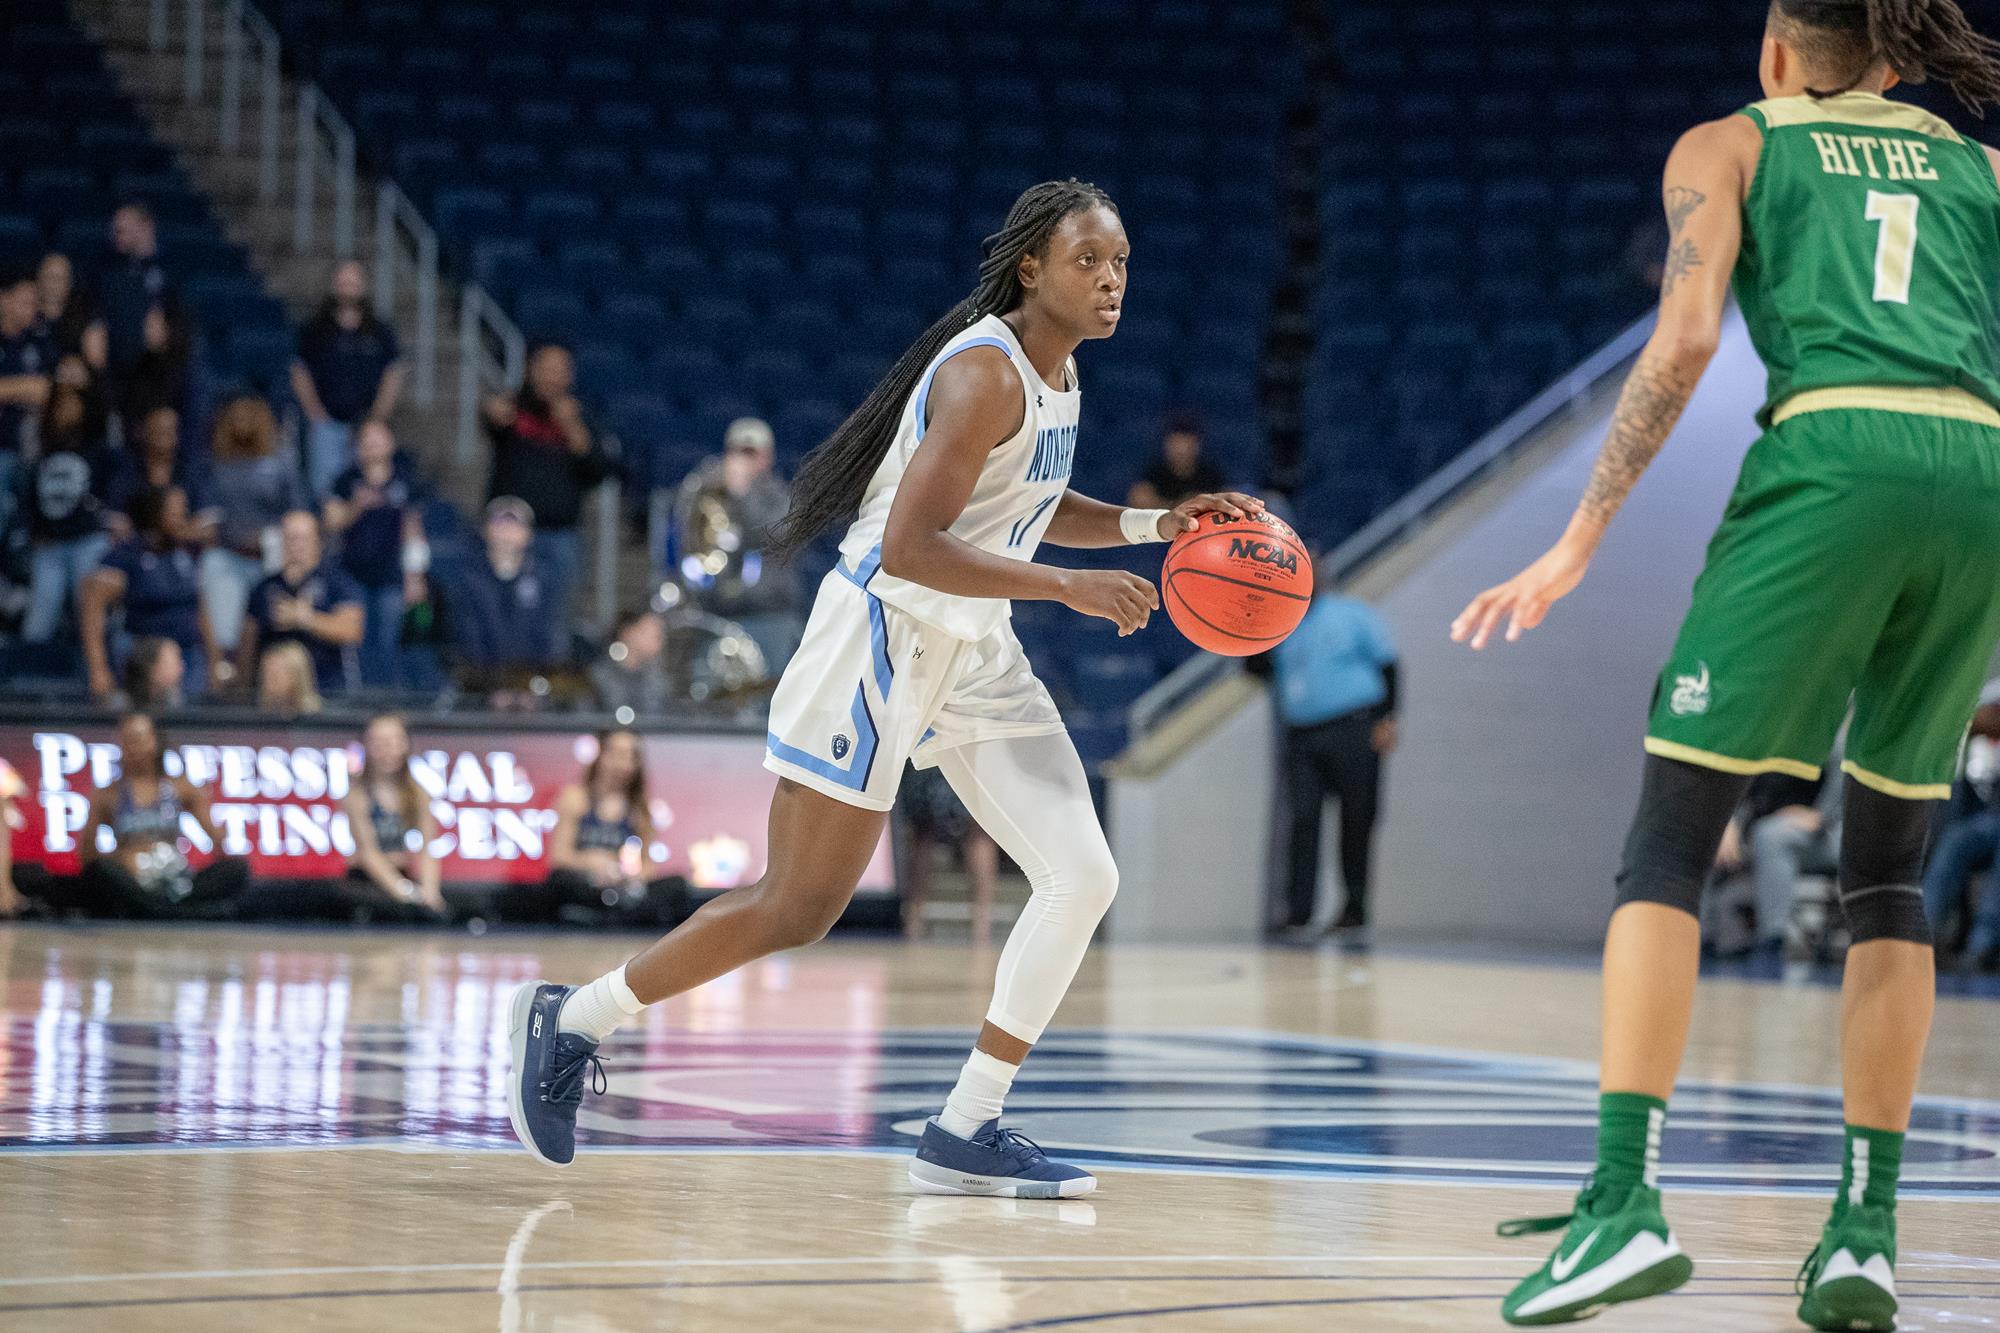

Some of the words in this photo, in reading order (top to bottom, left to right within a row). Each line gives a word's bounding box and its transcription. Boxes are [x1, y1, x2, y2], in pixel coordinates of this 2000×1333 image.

[1810, 132, 1939, 181] HITHE
[1864, 189, 1920, 305] 1
[1228, 538, 1297, 575] NCAA
[33, 733, 534, 803] PRFESSINAL
